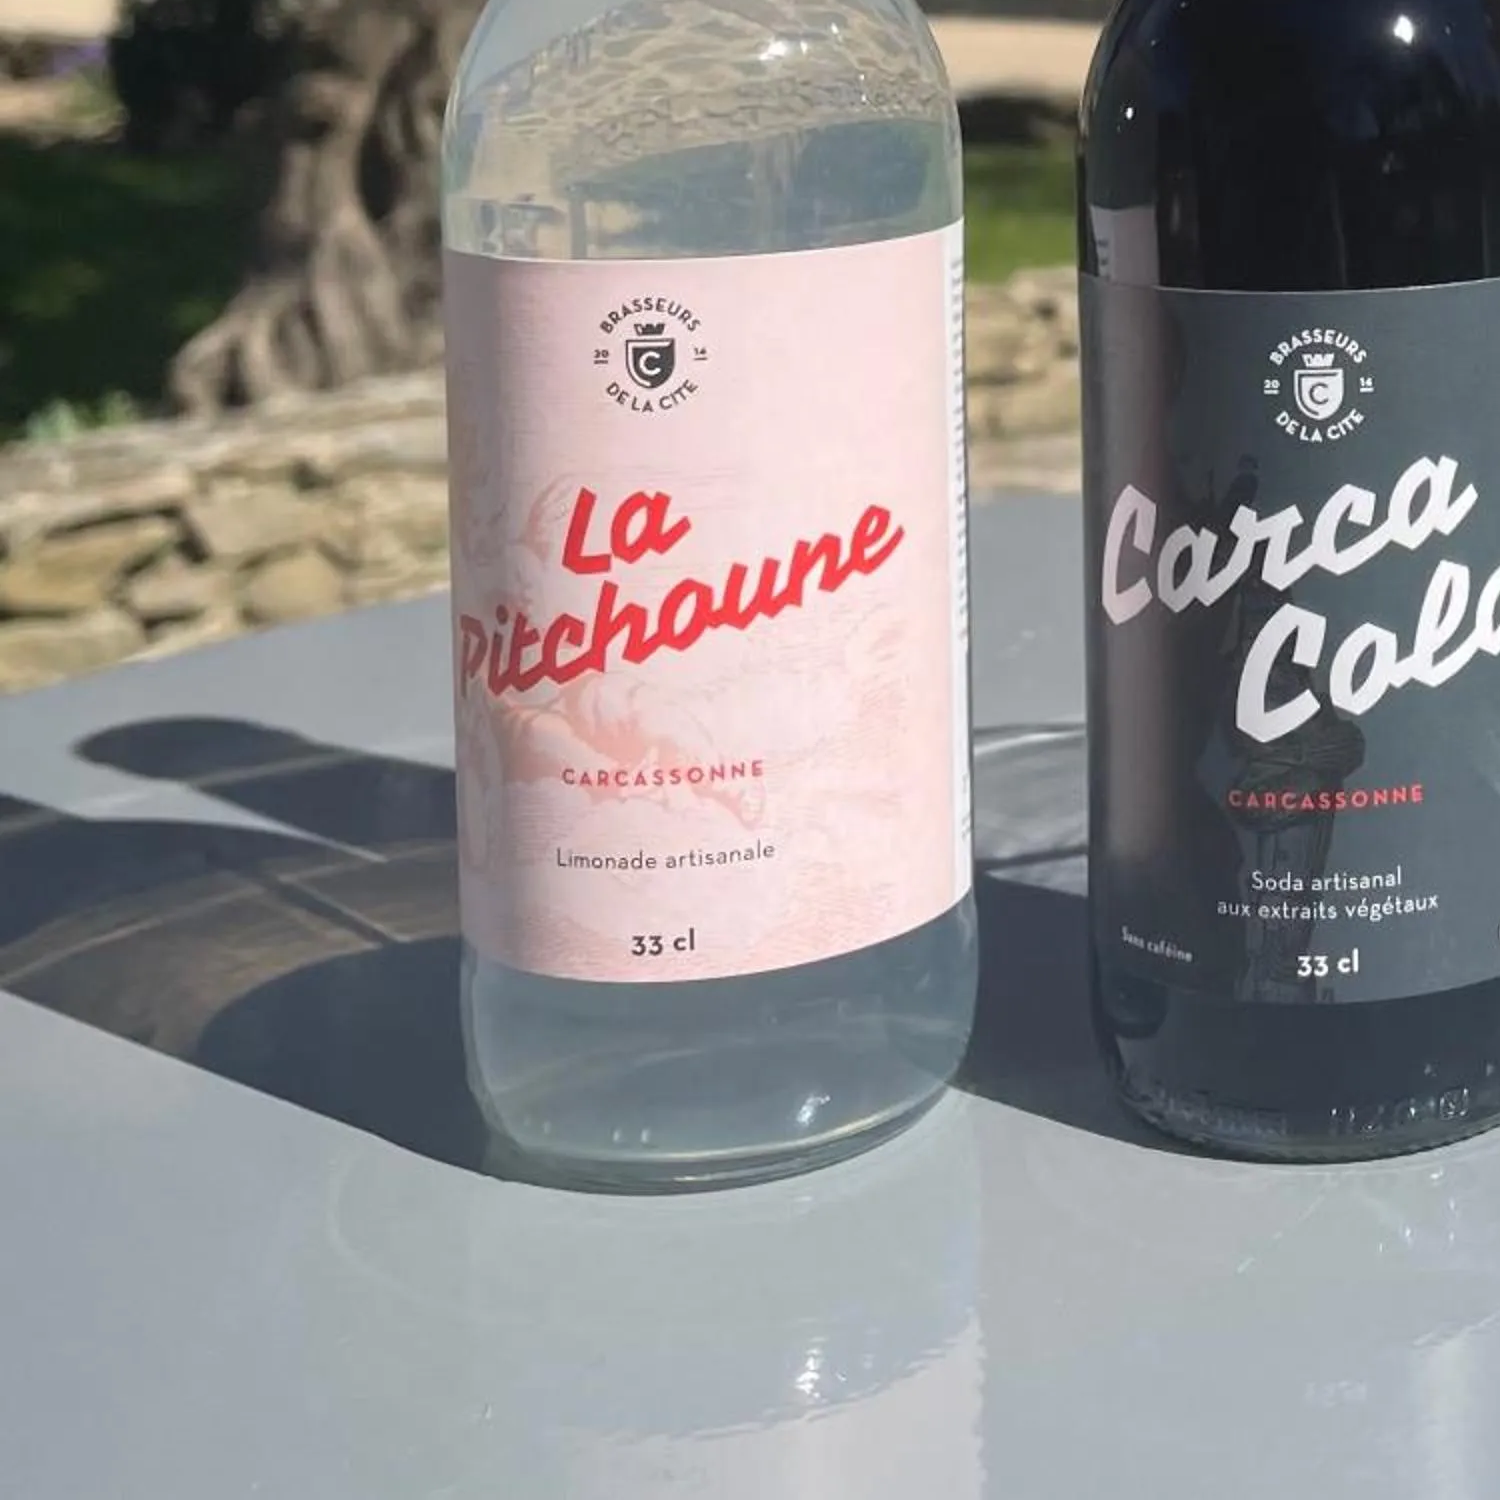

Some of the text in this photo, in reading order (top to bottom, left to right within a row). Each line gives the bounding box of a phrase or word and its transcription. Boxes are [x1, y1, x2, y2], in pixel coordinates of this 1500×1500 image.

[600, 297, 701, 335] BRASSEURS
[1269, 329, 1367, 365] BRASSEURS
[639, 351, 661, 376] C
[606, 379, 699, 413] DE LA CITE
[1309, 382, 1329, 405] C
[1275, 408, 1365, 442] DE LA CITE
[562, 485, 692, 575] La
[1100, 454, 1479, 626] Carca
[459, 503, 905, 700] Pitchoune
[561, 759, 765, 787] CARCASSONNE
[1228, 784, 1425, 811] CARCASSONNE
[556, 838, 776, 870] Limonade artisanale
[1252, 864, 1402, 892] Soda artisanal
[1217, 893, 1440, 921] aux extraits végétaux
[631, 927, 696, 956] 33 cl
[1297, 947, 1360, 976] 33 cl
